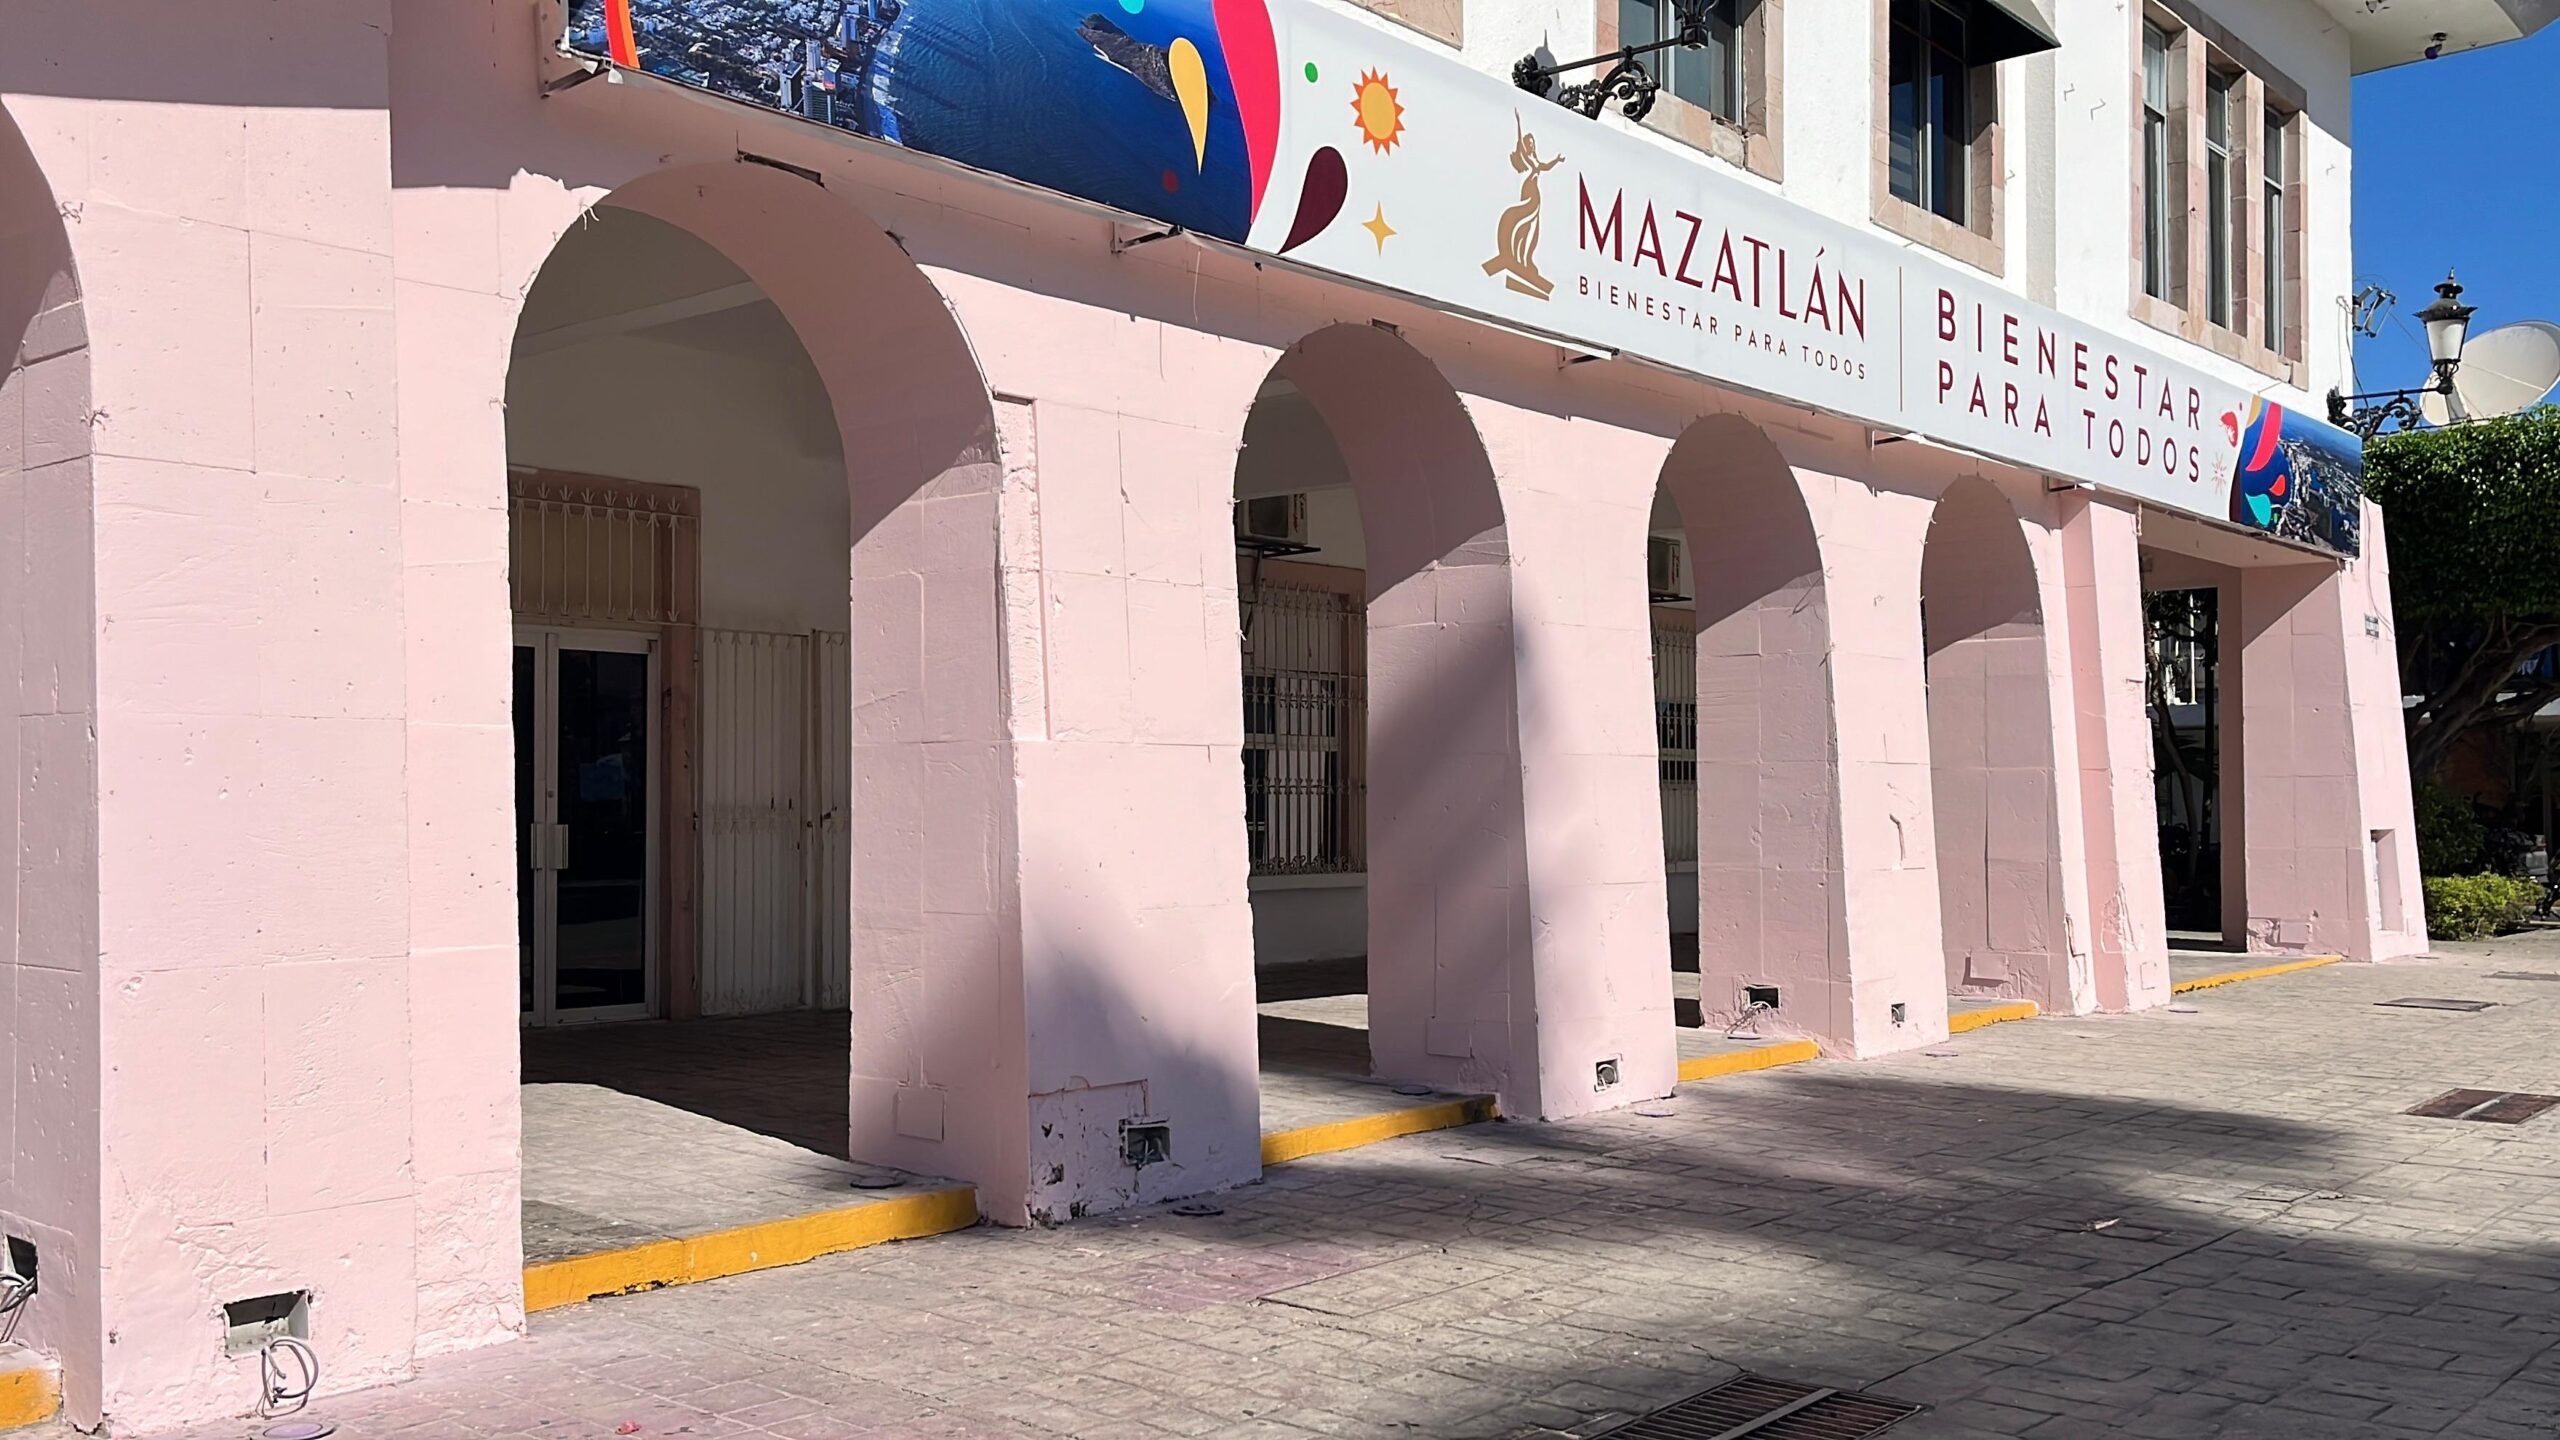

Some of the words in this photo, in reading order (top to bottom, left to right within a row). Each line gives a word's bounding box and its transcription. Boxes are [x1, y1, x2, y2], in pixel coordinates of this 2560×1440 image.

[1579, 171, 1865, 343] MAZATLÁN
[1579, 276, 1718, 336] BIENESTAR
[1735, 324, 1788, 357] PARA
[1802, 345, 1866, 381] TODOS
[1938, 287, 2200, 431] BIENESTAR
[1939, 360, 2052, 438] PARA
[2083, 408, 2200, 483] TODOS
